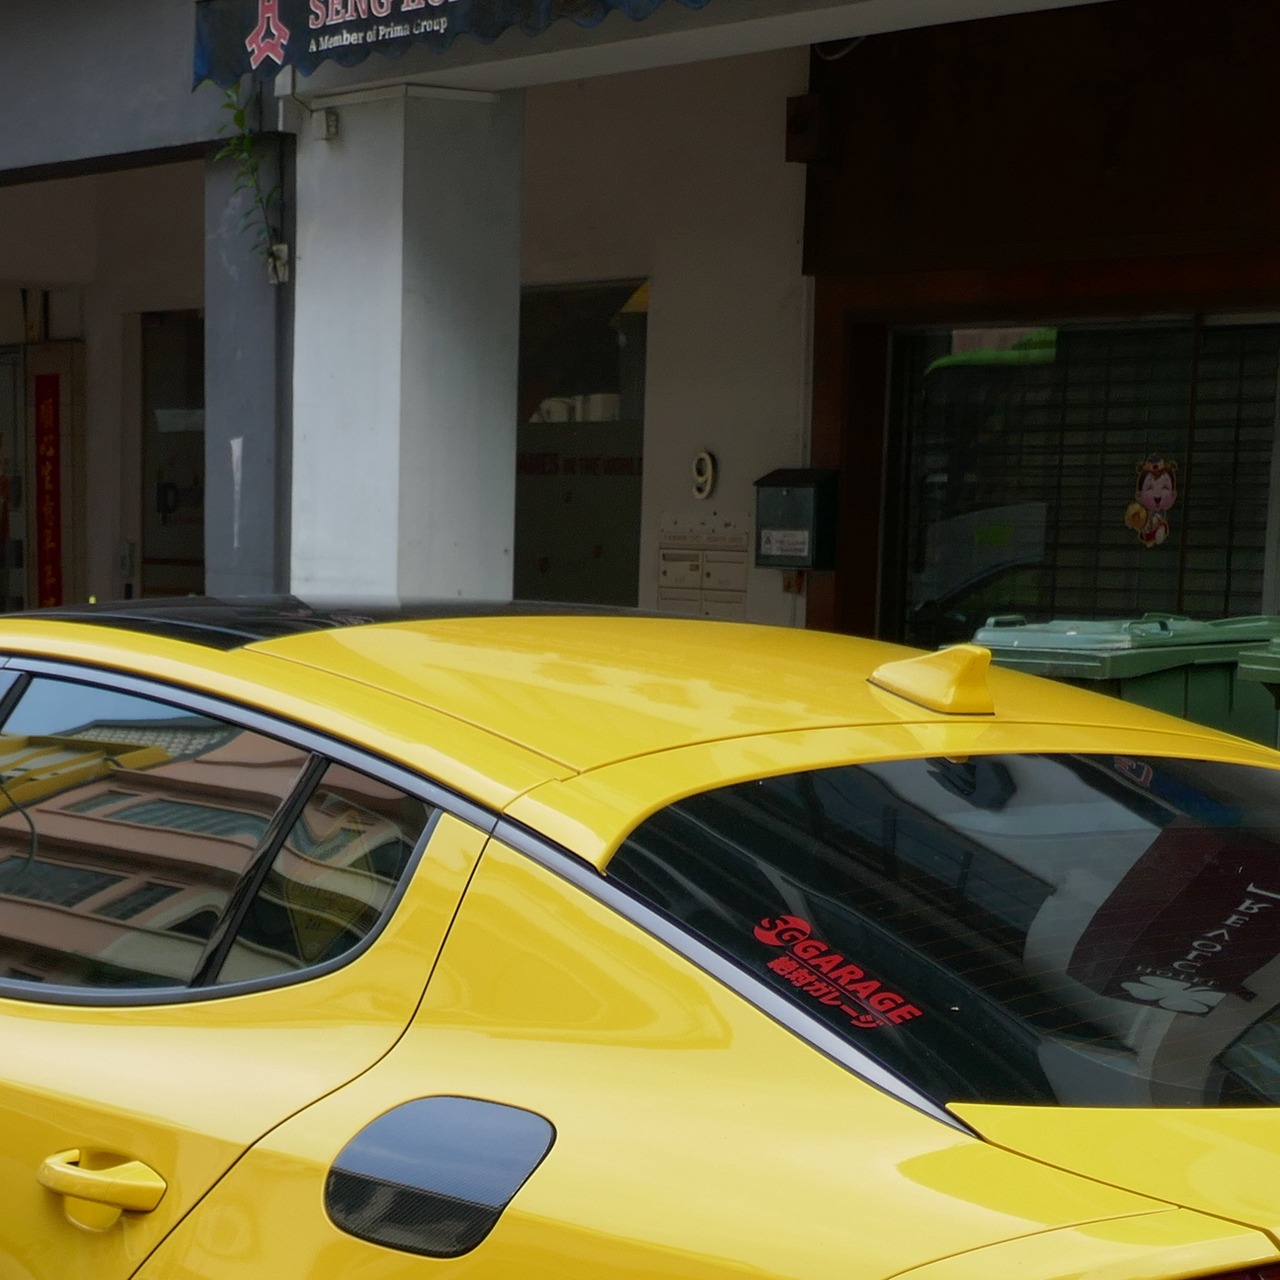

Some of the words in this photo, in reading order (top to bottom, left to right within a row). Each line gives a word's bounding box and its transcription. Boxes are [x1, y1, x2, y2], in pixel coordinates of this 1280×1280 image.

[308, 38, 317, 53] A
[319, 29, 365, 50] Member
[366, 26, 378, 43] of
[378, 22, 410, 41] Prima
[413, 16, 449, 35] Group
[691, 449, 717, 500] 9
[793, 938, 924, 1025] GARAGE
